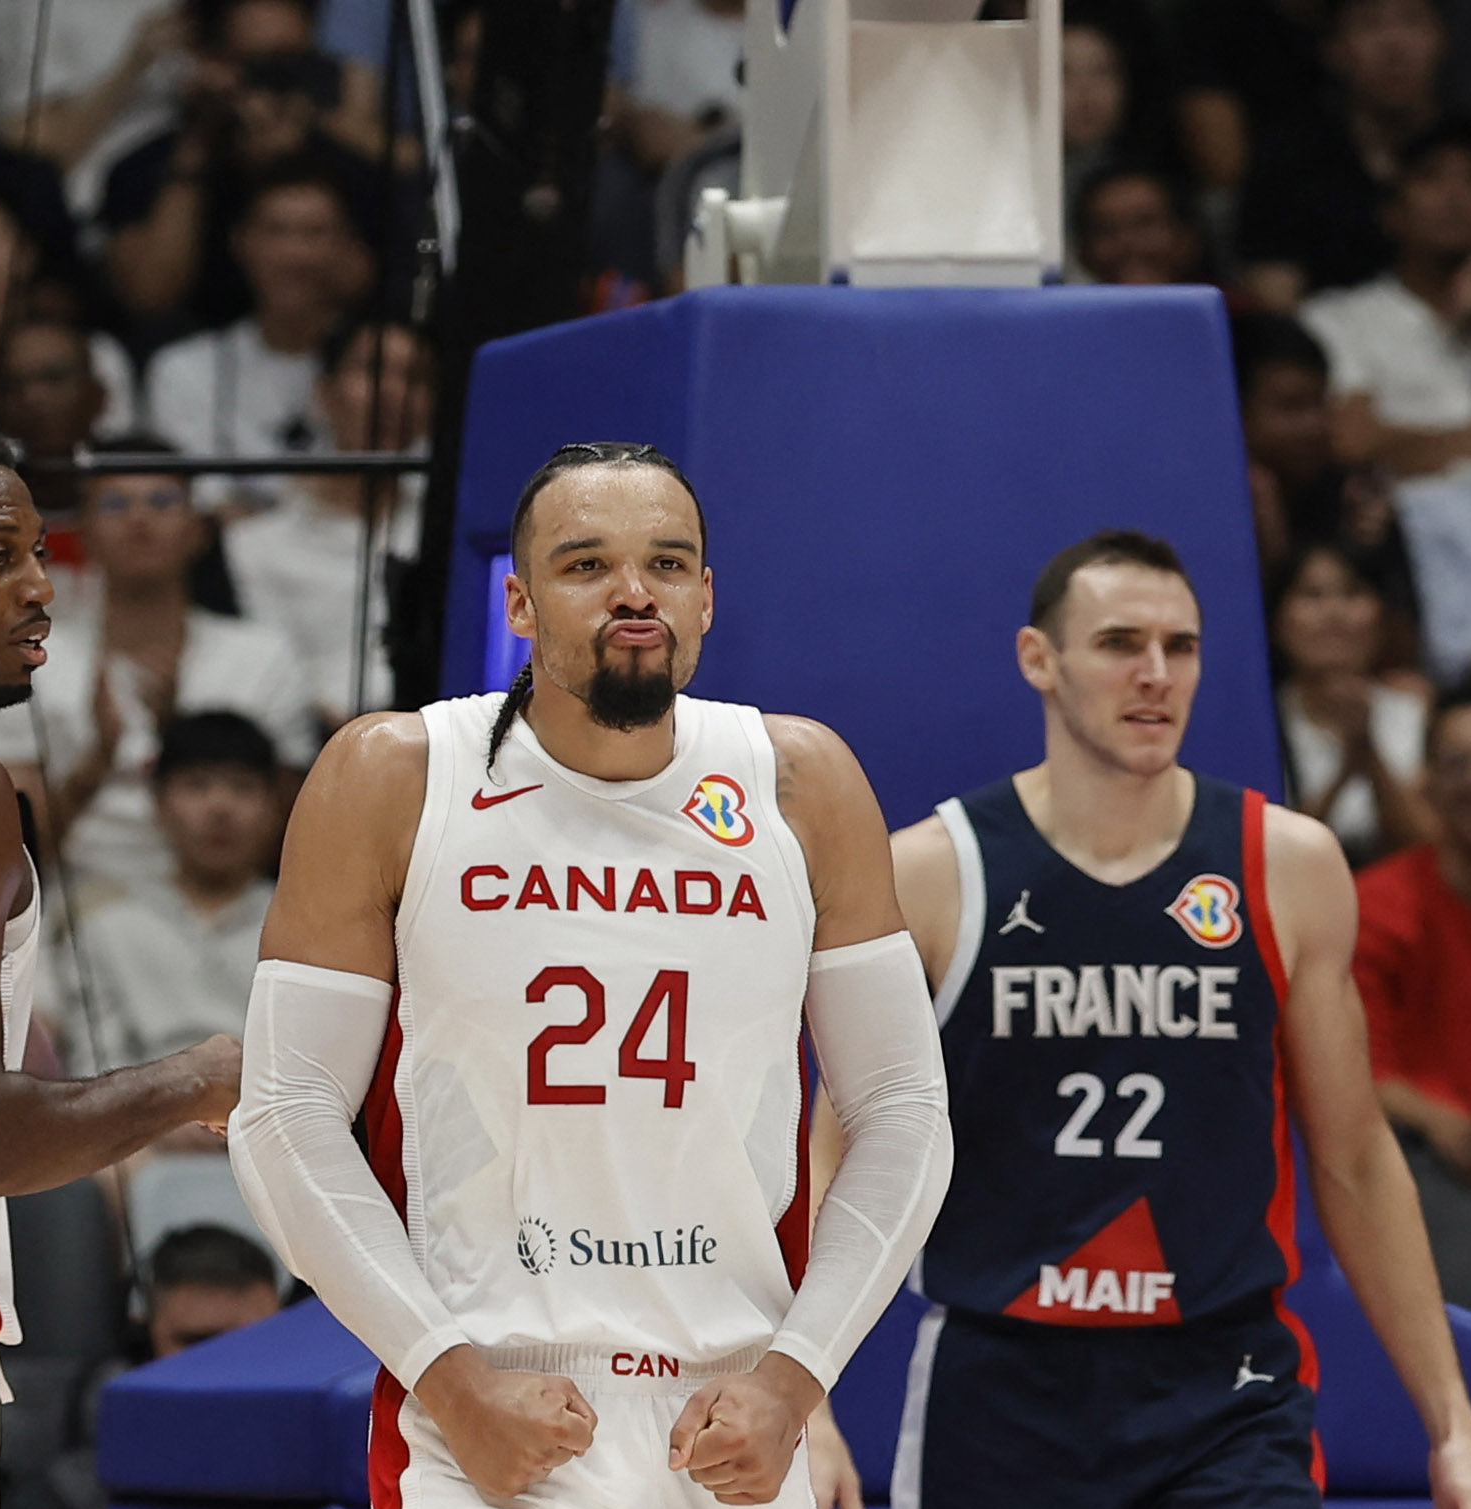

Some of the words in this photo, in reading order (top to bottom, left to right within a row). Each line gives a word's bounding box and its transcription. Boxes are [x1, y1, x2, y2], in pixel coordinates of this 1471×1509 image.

[460, 864, 768, 921] CANADA
[991, 965, 1238, 1039] FRANCE
[525, 965, 696, 1109] 24
[1055, 1073, 1163, 1158] 22
[1038, 1264, 1175, 1314] MAIF
[611, 1353, 679, 1378] CAN
